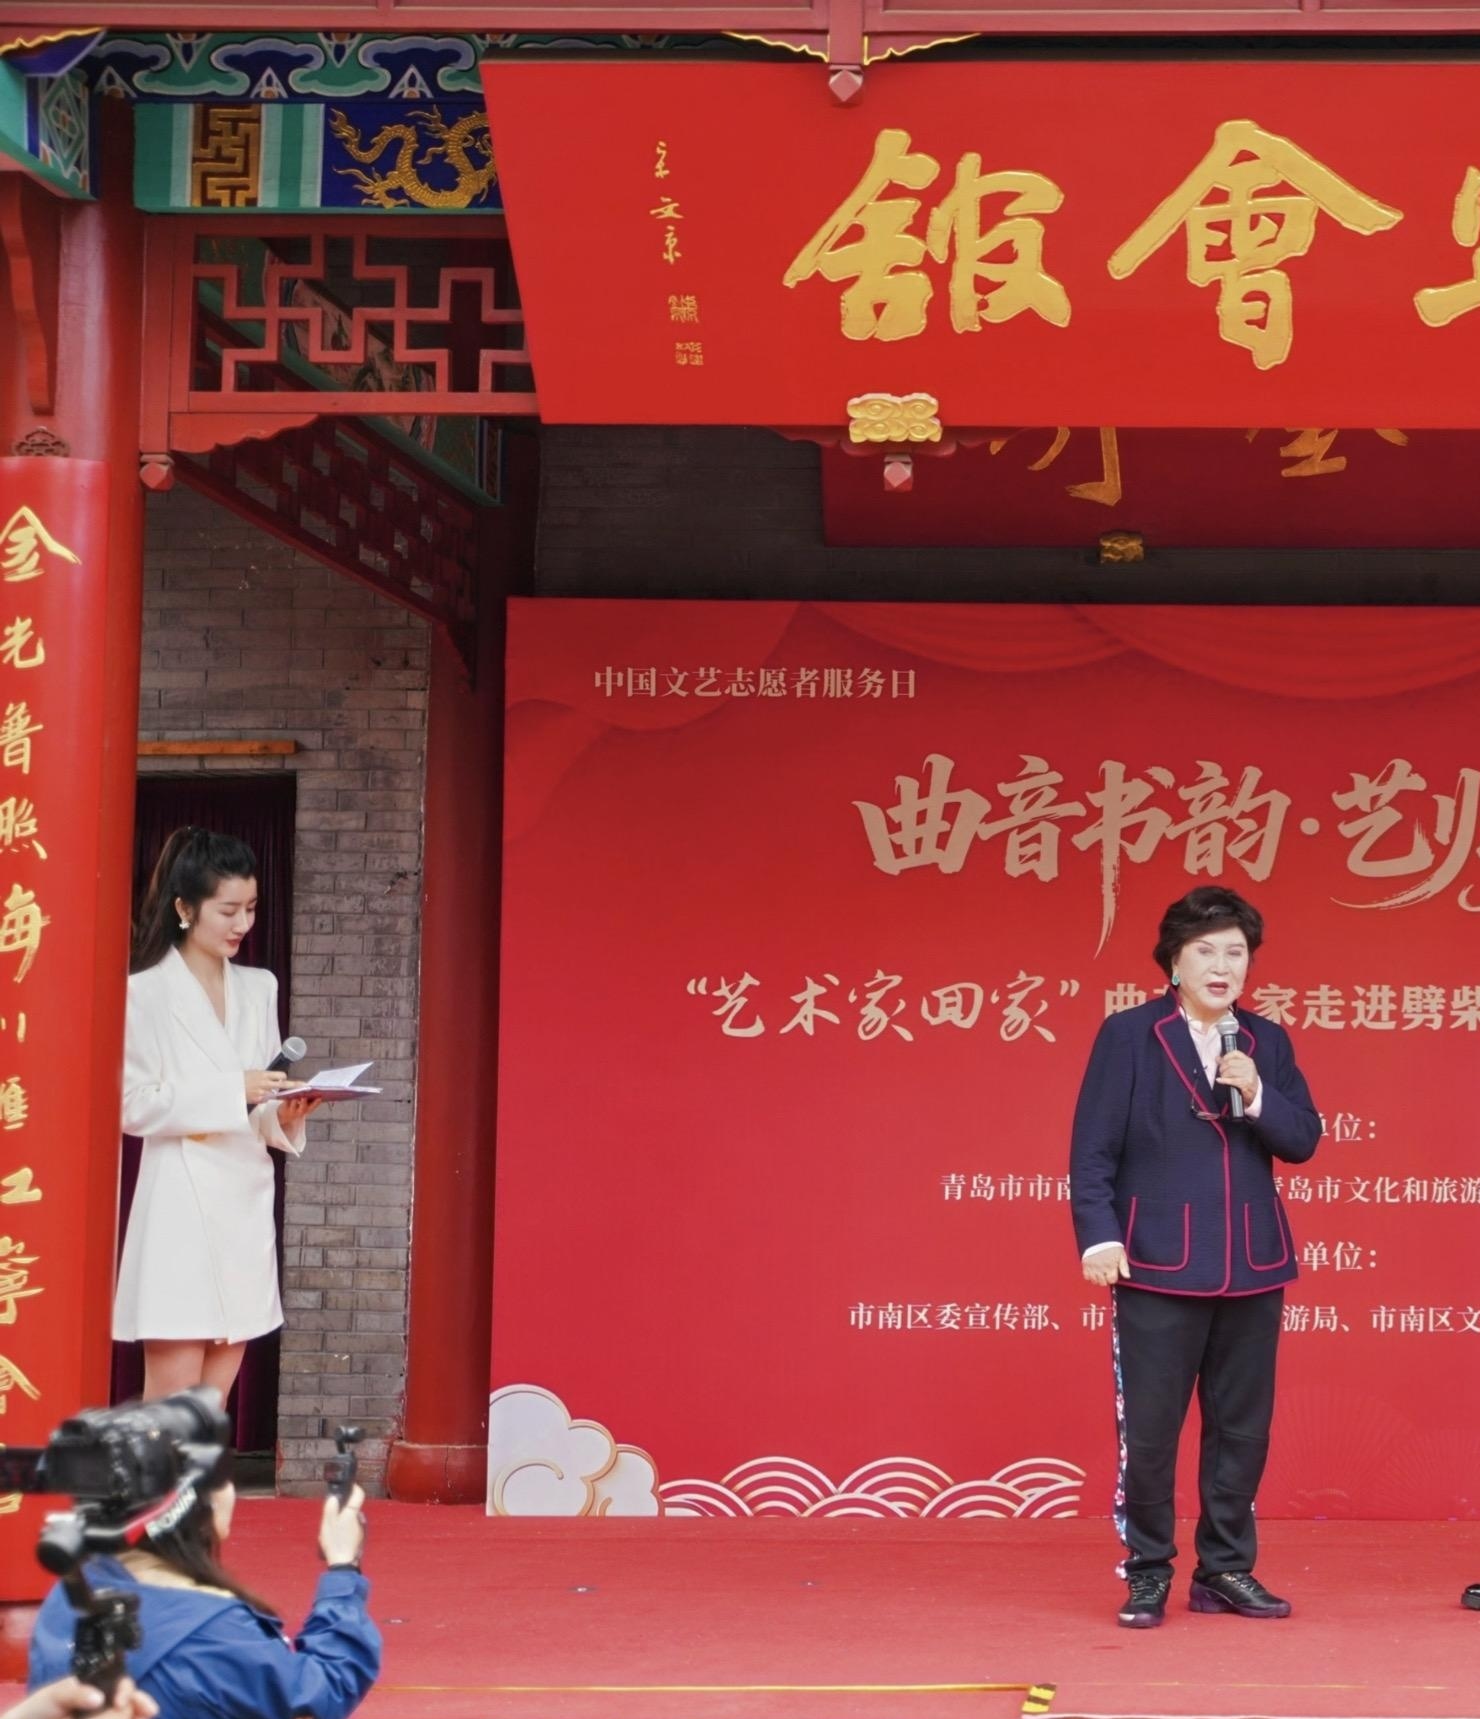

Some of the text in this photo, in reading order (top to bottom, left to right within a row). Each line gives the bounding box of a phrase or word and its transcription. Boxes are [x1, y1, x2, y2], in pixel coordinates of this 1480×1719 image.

[594, 666, 917, 698] 中国文艺志愿者服务日
[686, 968, 1080, 1043] “艺术家回家”
